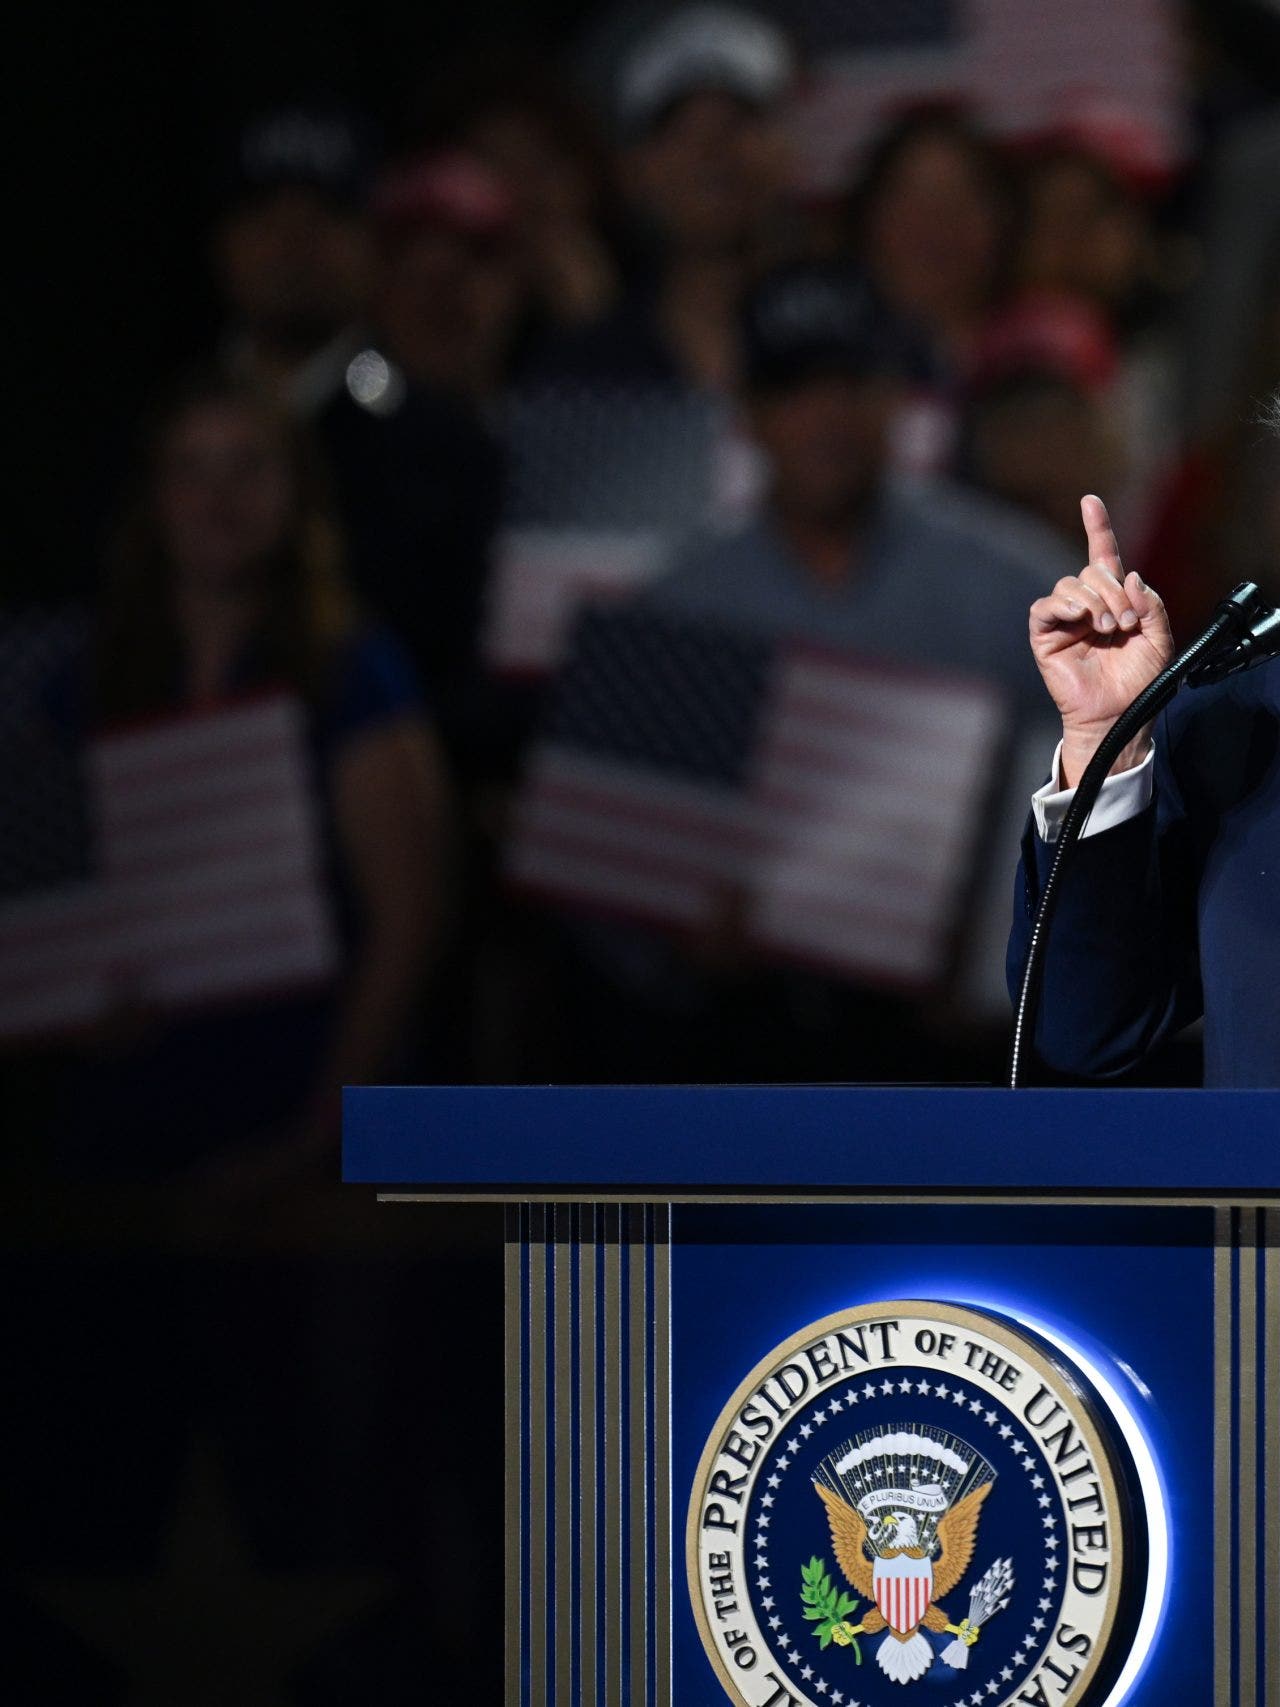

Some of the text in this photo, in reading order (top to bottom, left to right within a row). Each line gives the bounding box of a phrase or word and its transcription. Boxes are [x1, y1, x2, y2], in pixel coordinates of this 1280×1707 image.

[703, 1320, 1108, 1707] OF THE PRESIDENT OF THE UNITED STA
[861, 1491, 944, 1510] E PLURIBUS UNUM
